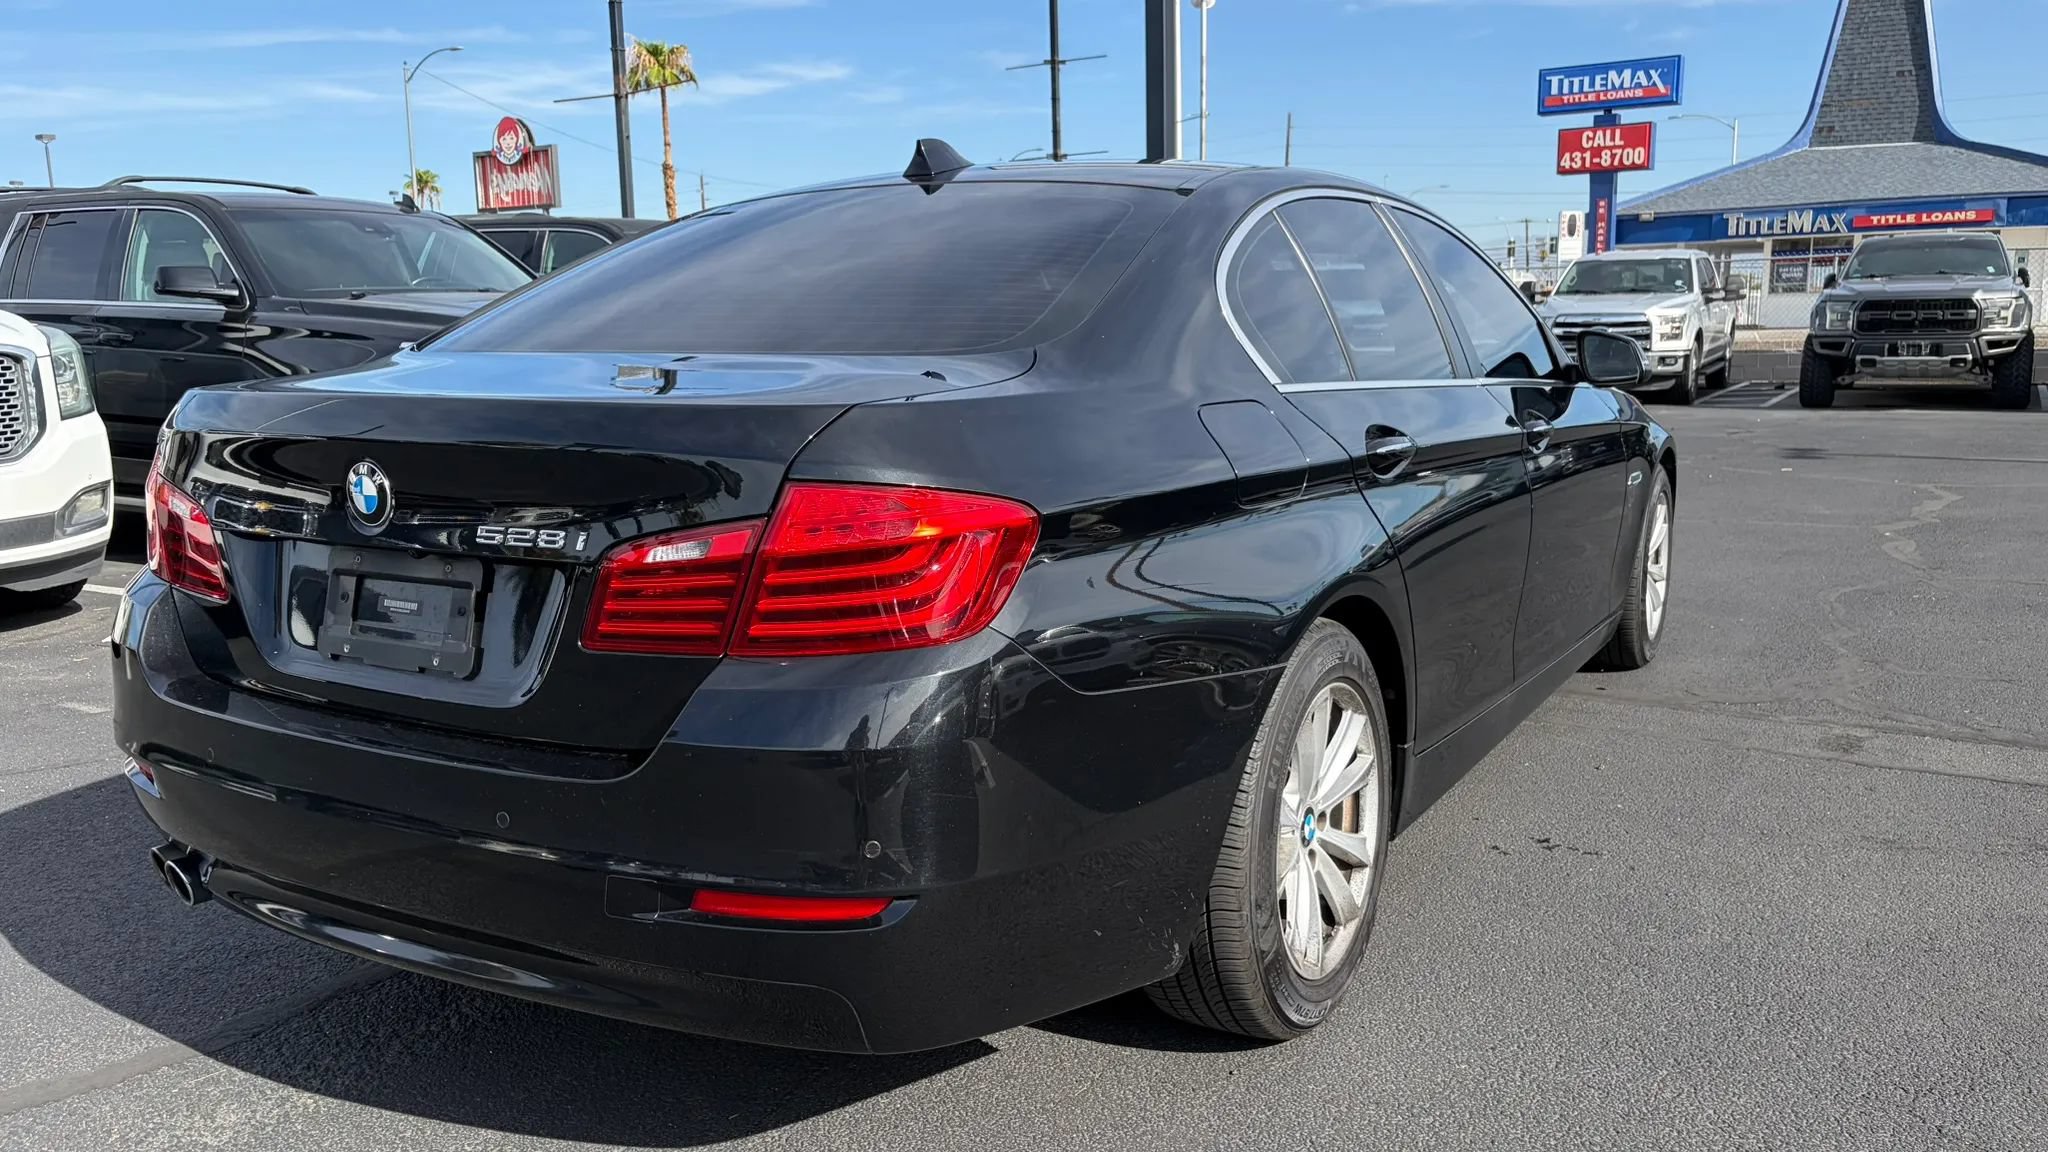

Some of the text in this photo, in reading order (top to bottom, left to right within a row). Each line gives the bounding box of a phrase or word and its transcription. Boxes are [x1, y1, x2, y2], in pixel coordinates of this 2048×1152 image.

[1562, 88, 1643, 104] TITLE LOANS
[1581, 128, 1624, 149] CALL
[1560, 147, 1645, 169] 431-8700
[1870, 211, 1977, 225] TITLE LOANS
[1860, 309, 1977, 320] FORD
